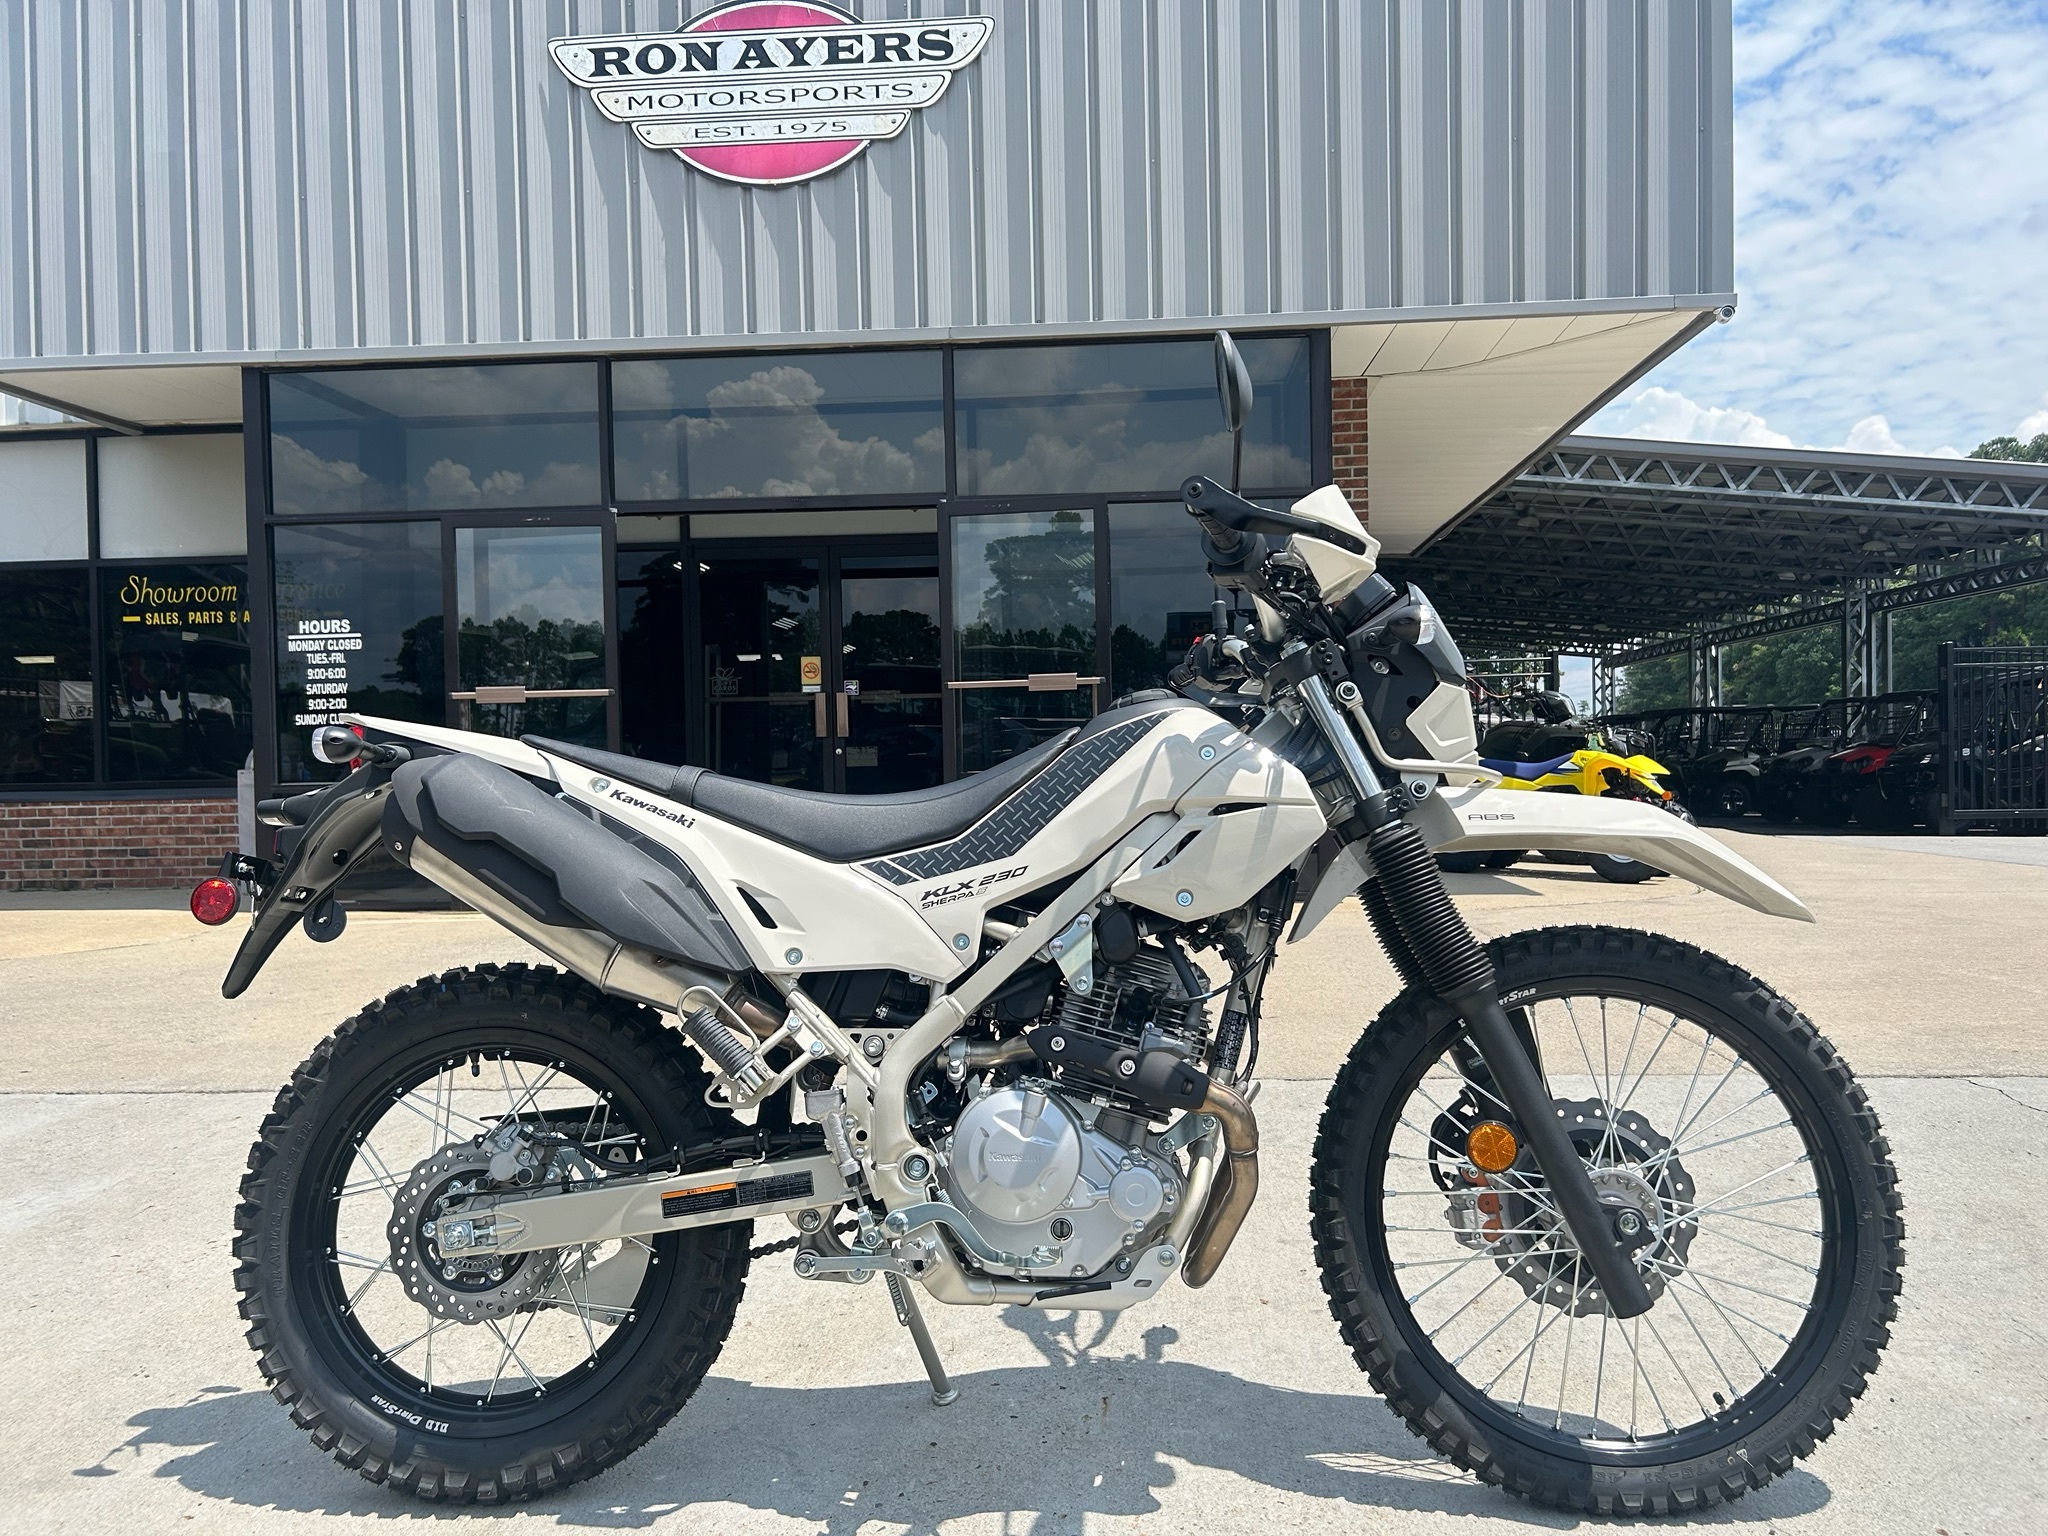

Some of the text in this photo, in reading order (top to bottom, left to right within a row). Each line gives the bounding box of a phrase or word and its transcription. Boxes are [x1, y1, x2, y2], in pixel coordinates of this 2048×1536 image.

[587, 28, 954, 78] RON AYERS
[627, 82, 914, 111] MOTORSPORTS
[694, 120, 847, 139] EST. 1975
[120, 575, 237, 607] Showroom
[145, 612, 183, 626] SALES,
[189, 610, 223, 625] PARTS
[230, 610, 238, 624] &
[299, 619, 351, 634] HOURS
[288, 639, 362, 651] MONDAY CLOSED
[307, 667, 346, 679] 9:00-6:00
[306, 682, 348, 695] SATURDAY
[308, 697, 348, 710] 9:00-2:00
[295, 713, 328, 725] SUNDAY
[609, 789, 696, 829] Kawasaki
[919, 865, 1029, 901] KLX 230
[921, 891, 975, 910] SHERPA
[988, 1151, 1042, 1163] Kawasaki
[425, 1419, 450, 1434] DID
